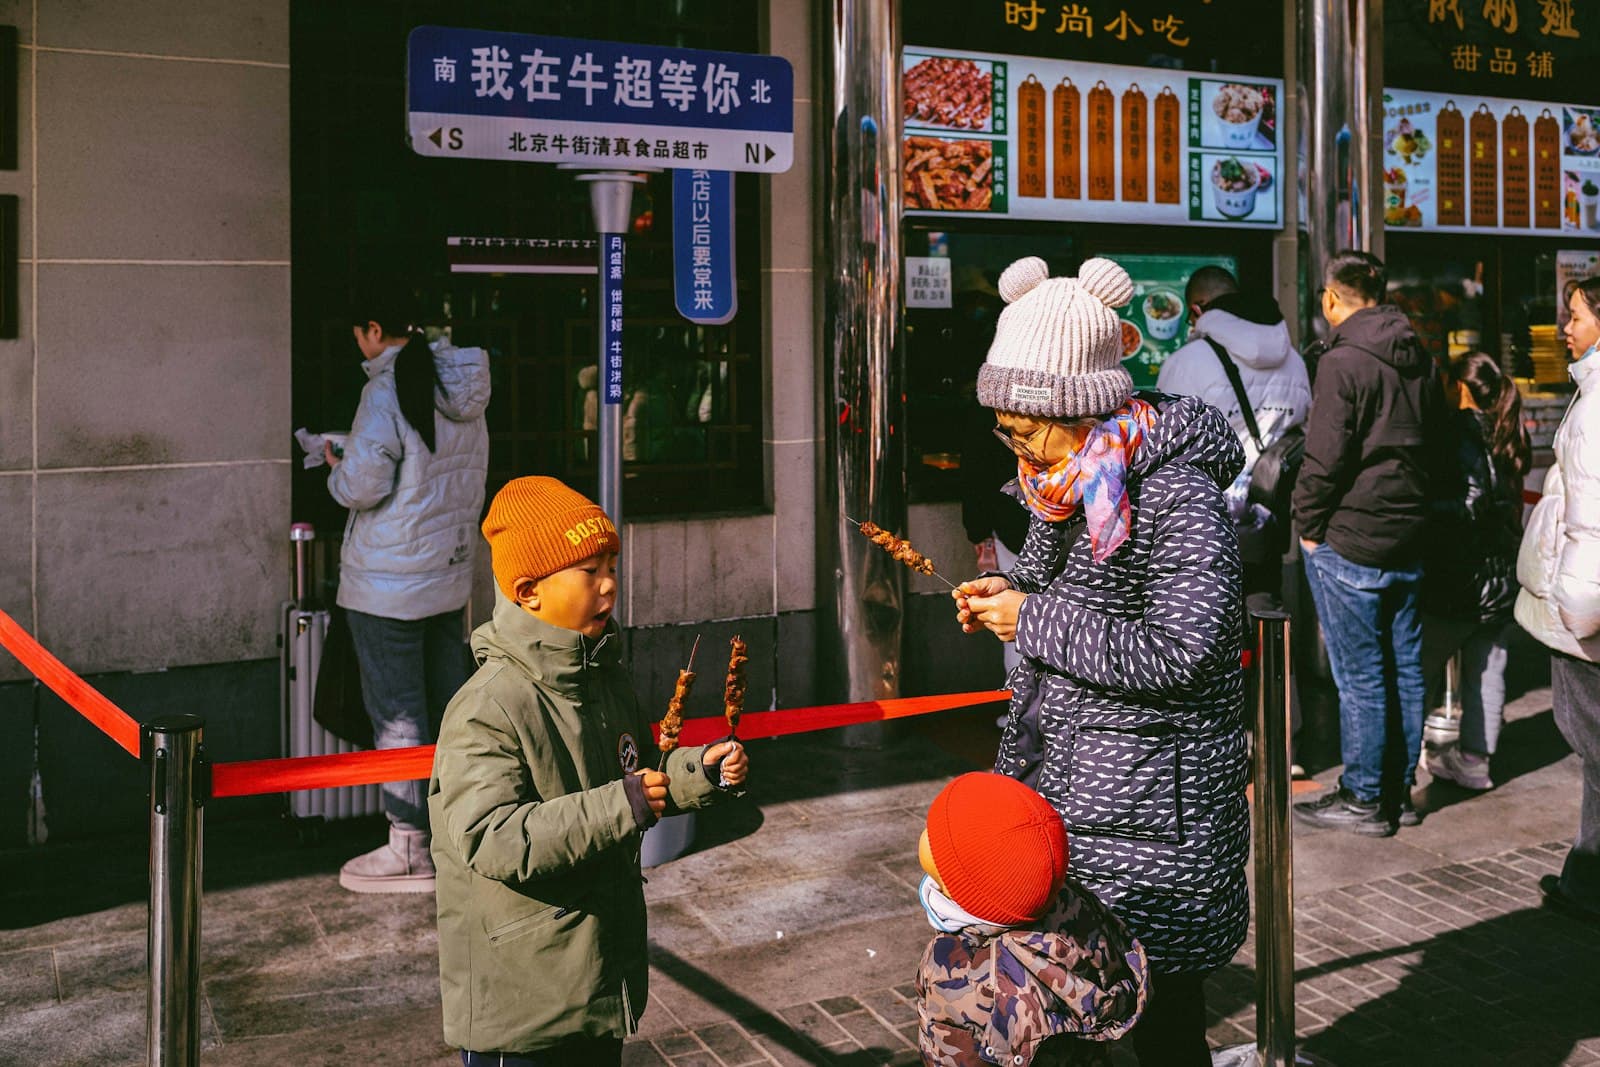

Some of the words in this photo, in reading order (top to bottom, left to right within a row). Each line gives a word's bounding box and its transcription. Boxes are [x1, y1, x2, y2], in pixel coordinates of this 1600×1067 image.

[1004, 0, 1190, 47] 时尚小吃
[1451, 45, 1555, 79] 甜品铺
[433, 56, 457, 84] 南
[470, 45, 741, 115] 我在牛超等你
[750, 79, 772, 104] 北
[448, 127, 464, 150] S
[508, 131, 709, 160] 北京牛街清真食品超市
[745, 142, 760, 164] N
